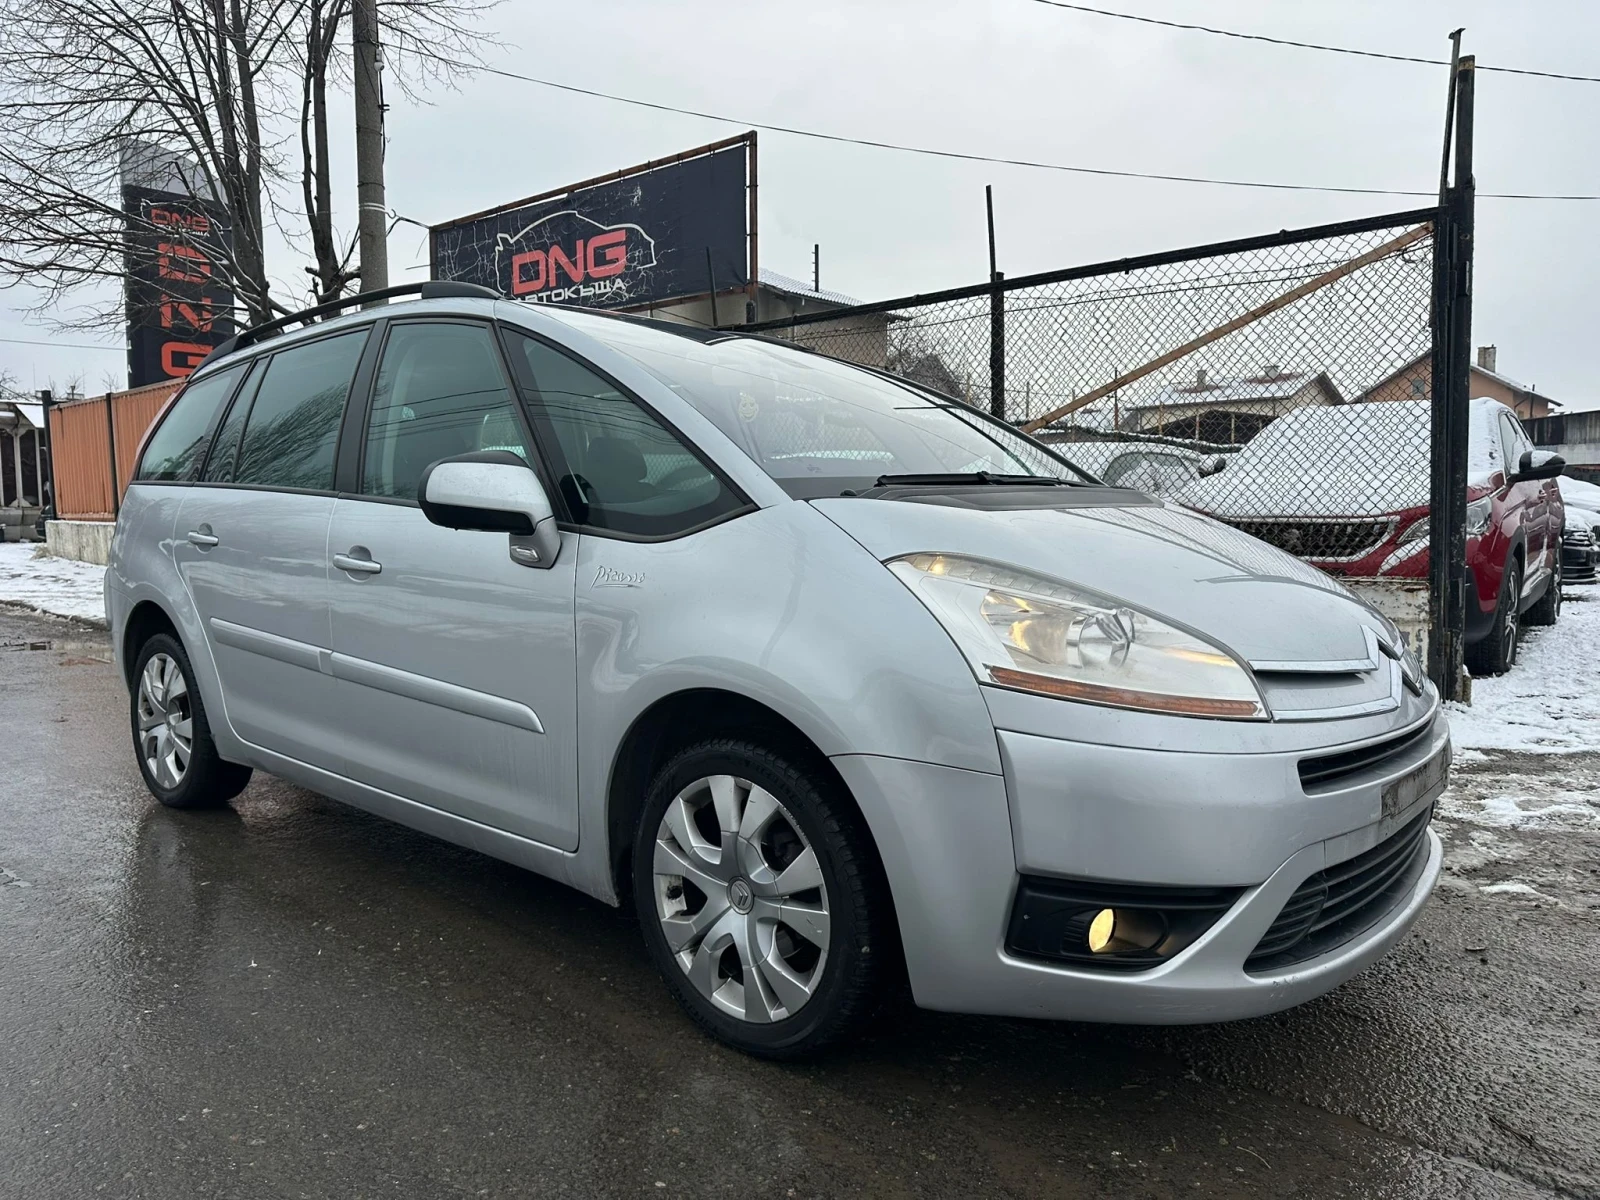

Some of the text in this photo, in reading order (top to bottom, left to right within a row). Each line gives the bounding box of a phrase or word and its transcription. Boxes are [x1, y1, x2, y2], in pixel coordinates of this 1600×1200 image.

[151, 208, 210, 233] DNG
[512, 229, 626, 295] DNG
[589, 565, 646, 592] Picasso
